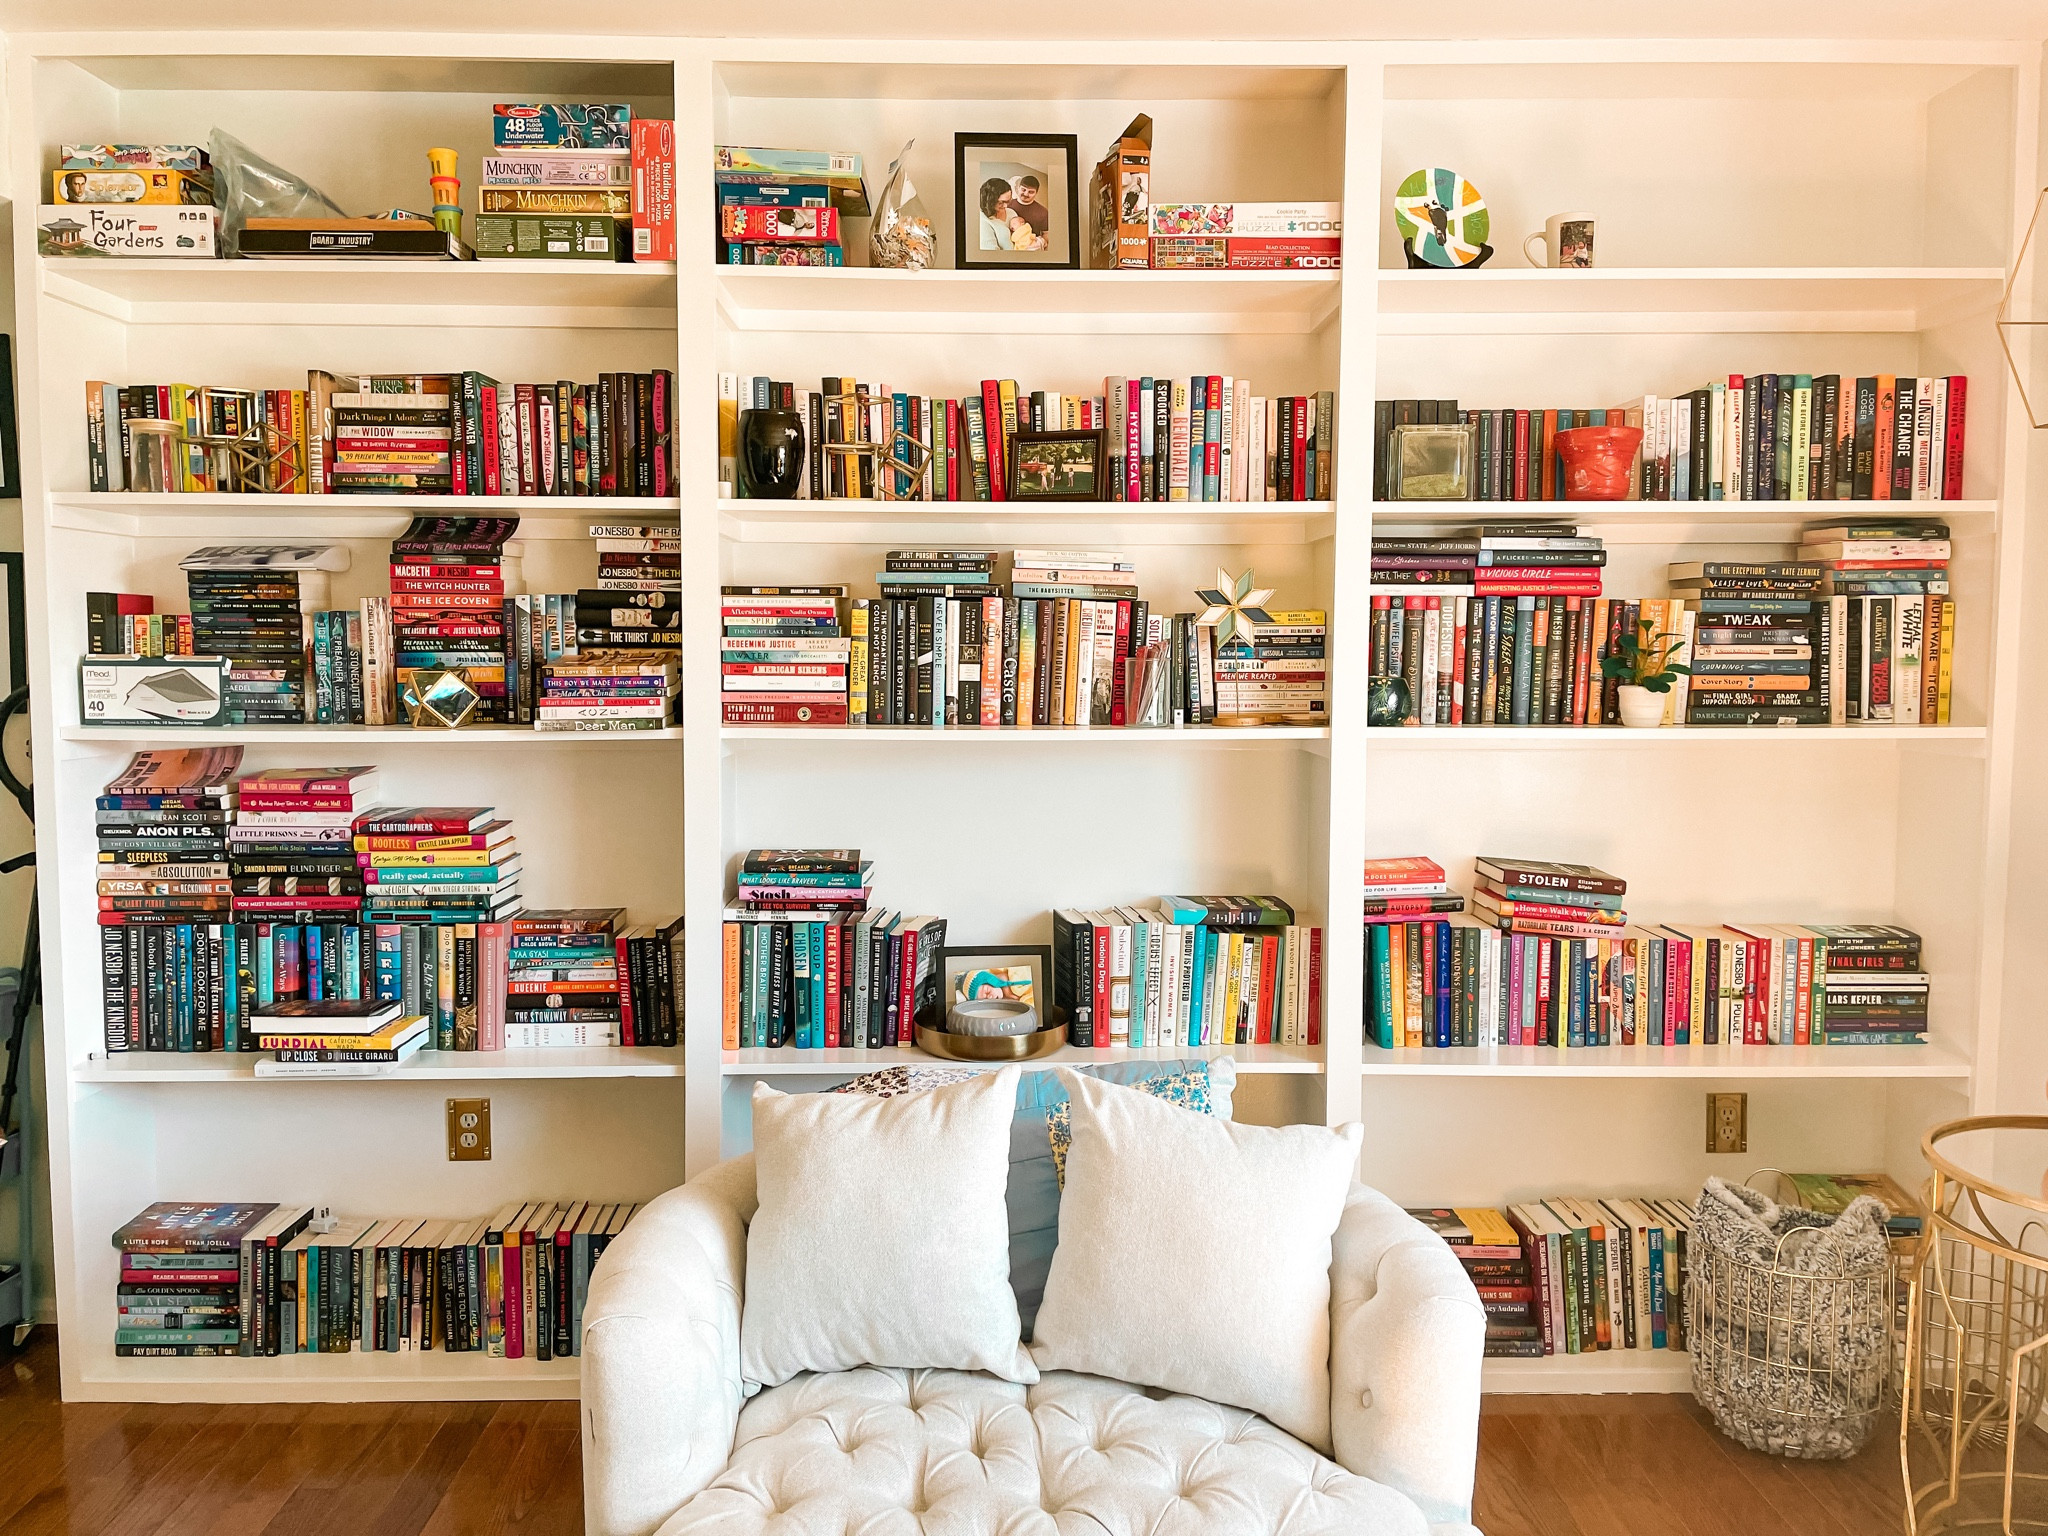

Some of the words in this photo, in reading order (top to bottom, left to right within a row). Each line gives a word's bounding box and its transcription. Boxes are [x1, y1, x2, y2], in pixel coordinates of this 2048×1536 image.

[505, 119, 525, 132] 48
[505, 132, 544, 140] Underwater
[486, 161, 542, 178] MUNCHKIN
[663, 162, 671, 200] Building
[516, 191, 587, 209] MUNCHKIN
[89, 210, 136, 231] Four
[767, 210, 776, 235] 1000
[1238, 224, 1286, 232] PUZZLE
[94, 231, 164, 249] Gardens
[312, 236, 334, 246] BOARD
[338, 235, 371, 246] INDUSTRY
[373, 385, 403, 393] KING
[464, 376, 473, 399] WADE
[1158, 385, 1166, 426] SPOOKED
[1900, 390, 1912, 411] THE
[395, 413, 417, 421] Adore
[485, 414, 493, 439] CRIME
[1918, 400, 1931, 436] UNSUB
[362, 428, 394, 436] WIDOW
[466, 418, 475, 445] WATER
[969, 407, 985, 461] TRUEVINE
[1192, 410, 1204, 446] RITUAL
[1898, 414, 1912, 457] CHANGE
[487, 442, 495, 468] STORY
[1918, 458, 1926, 491] GARDINER
[592, 527, 603, 536] JO
[395, 567, 430, 576] MACBETH
[1487, 569, 1519, 578] VICIOUS
[1521, 569, 1551, 578] CIRCLE
[424, 582, 452, 590] WITCH
[455, 582, 490, 590] HUNTER
[1081, 608, 1093, 642] CREDIBLE
[1722, 615, 1772, 625] TWEAK
[1875, 605, 1883, 652] GALBRAITH
[1902, 609, 1913, 649] WHITE
[1913, 603, 1922, 643] LETHAL
[610, 632, 623, 642] THE
[623, 632, 648, 643] THIRST
[1443, 607, 1453, 658] DOPESICK
[935, 636, 943, 668] SIMPLE
[1118, 636, 1128, 659] ROLL
[1929, 631, 1939, 661] WARE
[335, 640, 343, 682] PREACHER
[351, 651, 360, 708] STONECUTTER
[896, 666, 904, 707] BROTHER
[1004, 658, 1017, 702] Caste
[1115, 681, 1126, 706] ROLL
[88, 701, 104, 712] 40
[575, 721, 605, 730] Deer
[608, 721, 636, 730] Man
[137, 827, 179, 836] ANON
[183, 827, 214, 836] PLS.
[372, 839, 410, 848] ROOTLESS
[127, 853, 168, 862] SLEEPLESS
[158, 867, 211, 877] ABSOLUTION
[1519, 874, 1569, 887] STOLEN
[180, 884, 212, 893] RECKONING
[751, 890, 790, 900] Stash
[1550, 907, 1569, 915] Walk
[1572, 909, 1591, 917] Away
[1518, 921, 1548, 931] RAZORBLADE
[1550, 924, 1574, 933] TEARS
[240, 939, 248, 965] STALKER
[794, 933, 806, 971] CHOSEN
[1098, 936, 1106, 968] Undoing
[1828, 957, 1853, 966] FINAL
[1857, 957, 1884, 967] GIRLS
[515, 984, 547, 992] QUEENIE
[828, 972, 837, 993] MAN
[1098, 970, 1106, 993] Drugs
[106, 986, 124, 1004] THE
[1827, 996, 1848, 1004] LARS
[1851, 995, 1881, 1005] KEPLER
[107, 1006, 128, 1051] KINGDOM
[263, 1039, 327, 1049] SUNDIAL
[281, 1051, 291, 1061] UP
[294, 1051, 317, 1061] CLOSE
[1610, 1238, 1618, 1271] DESPERATE
